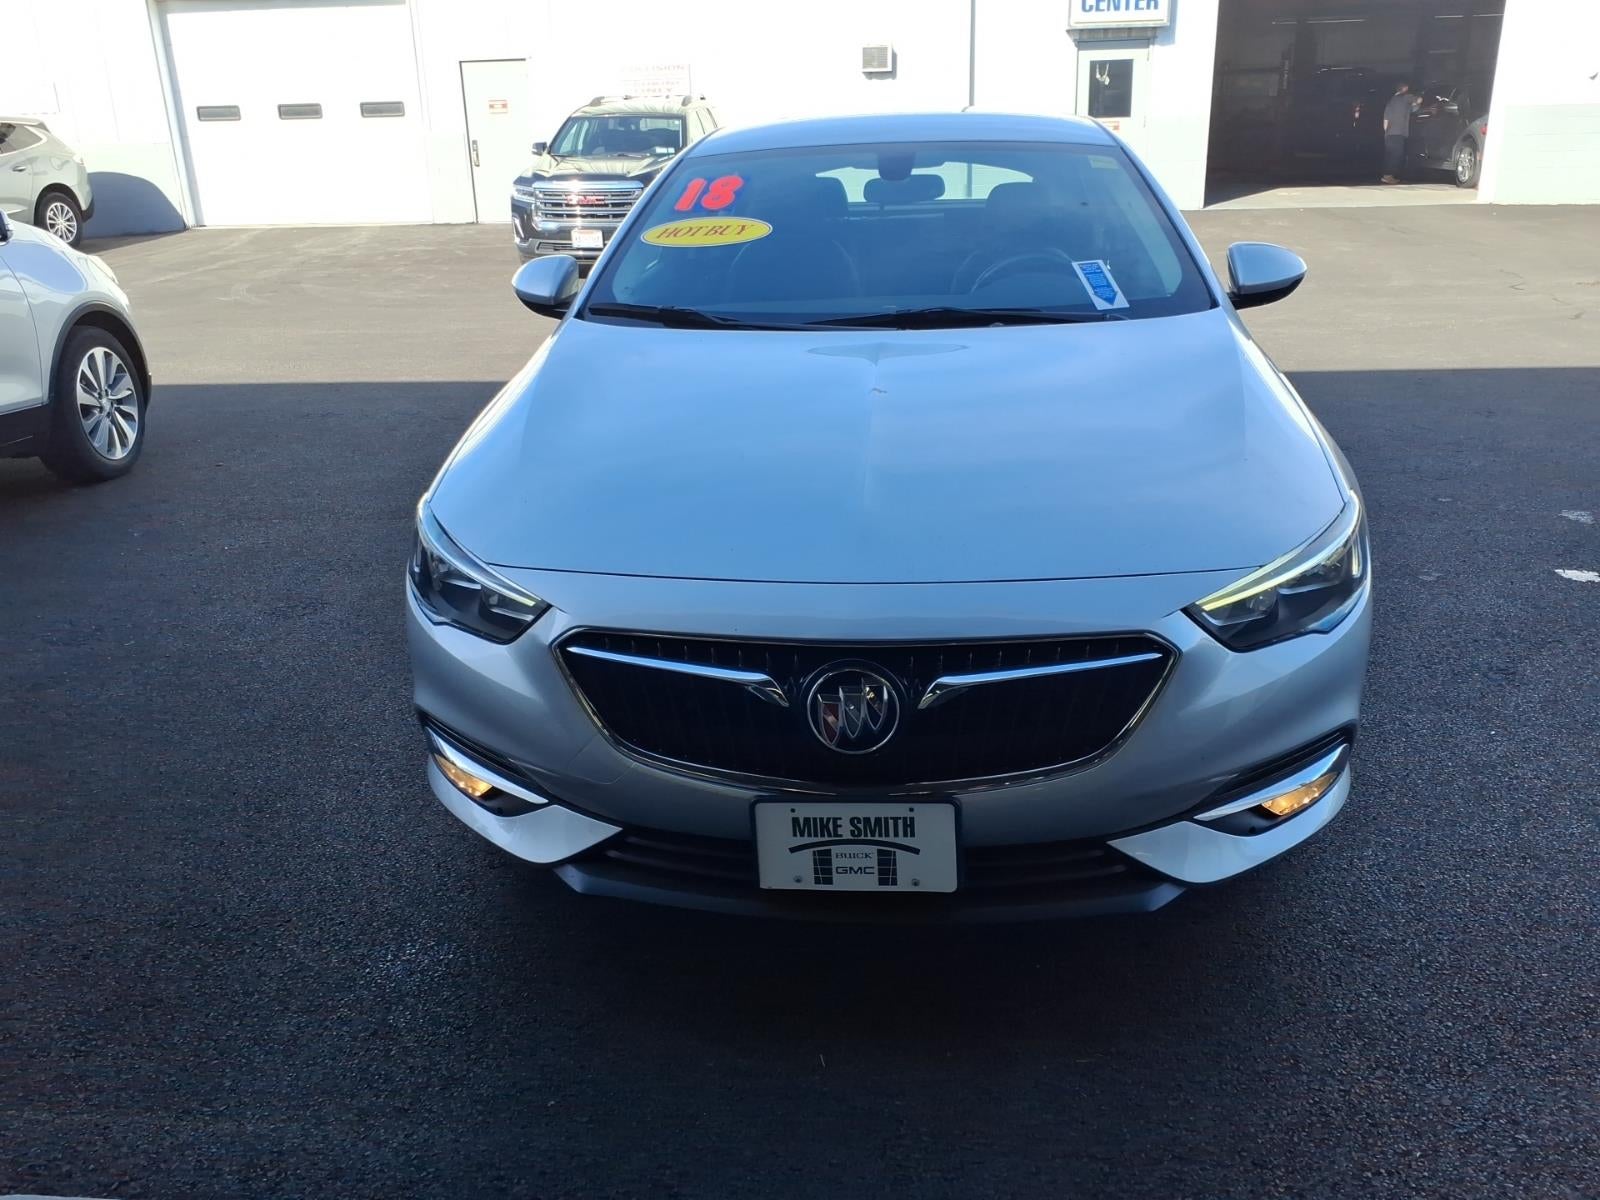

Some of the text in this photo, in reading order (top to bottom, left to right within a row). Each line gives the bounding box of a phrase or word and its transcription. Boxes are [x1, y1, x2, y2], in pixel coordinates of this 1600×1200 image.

[674, 175, 744, 212] 18
[656, 223, 756, 239] HOT BUY
[791, 816, 916, 838] MIKE SMITH
[835, 866, 875, 875] GMC
